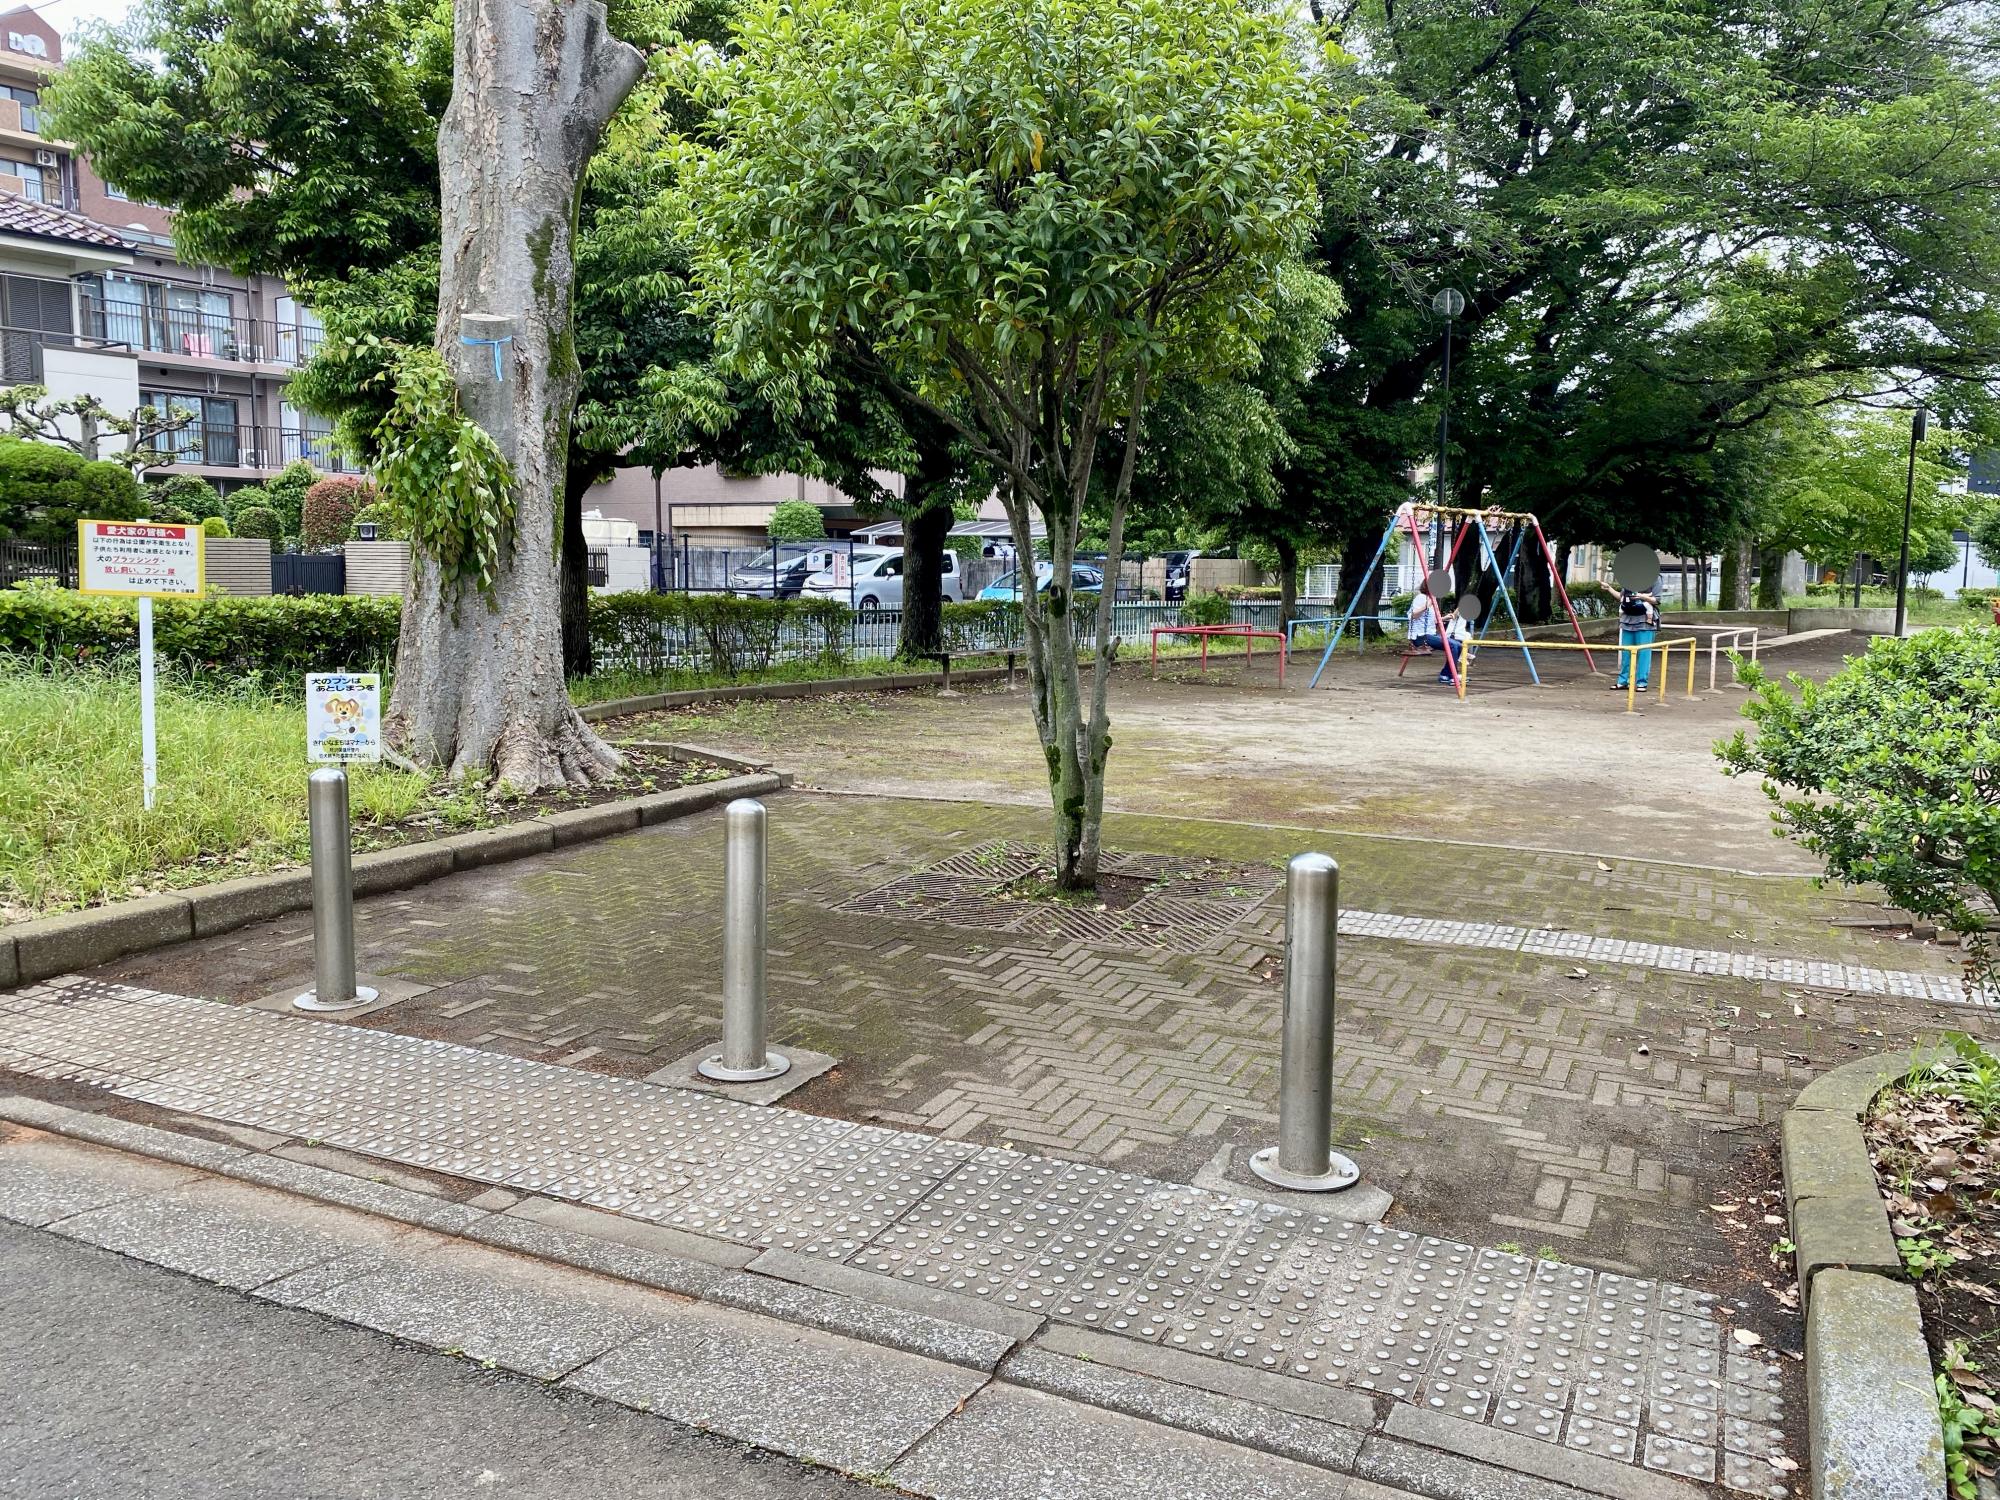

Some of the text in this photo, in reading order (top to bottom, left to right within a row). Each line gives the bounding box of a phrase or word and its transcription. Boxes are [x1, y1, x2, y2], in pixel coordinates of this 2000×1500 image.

[107, 526, 175, 537] 愛犬家の皆様へ
